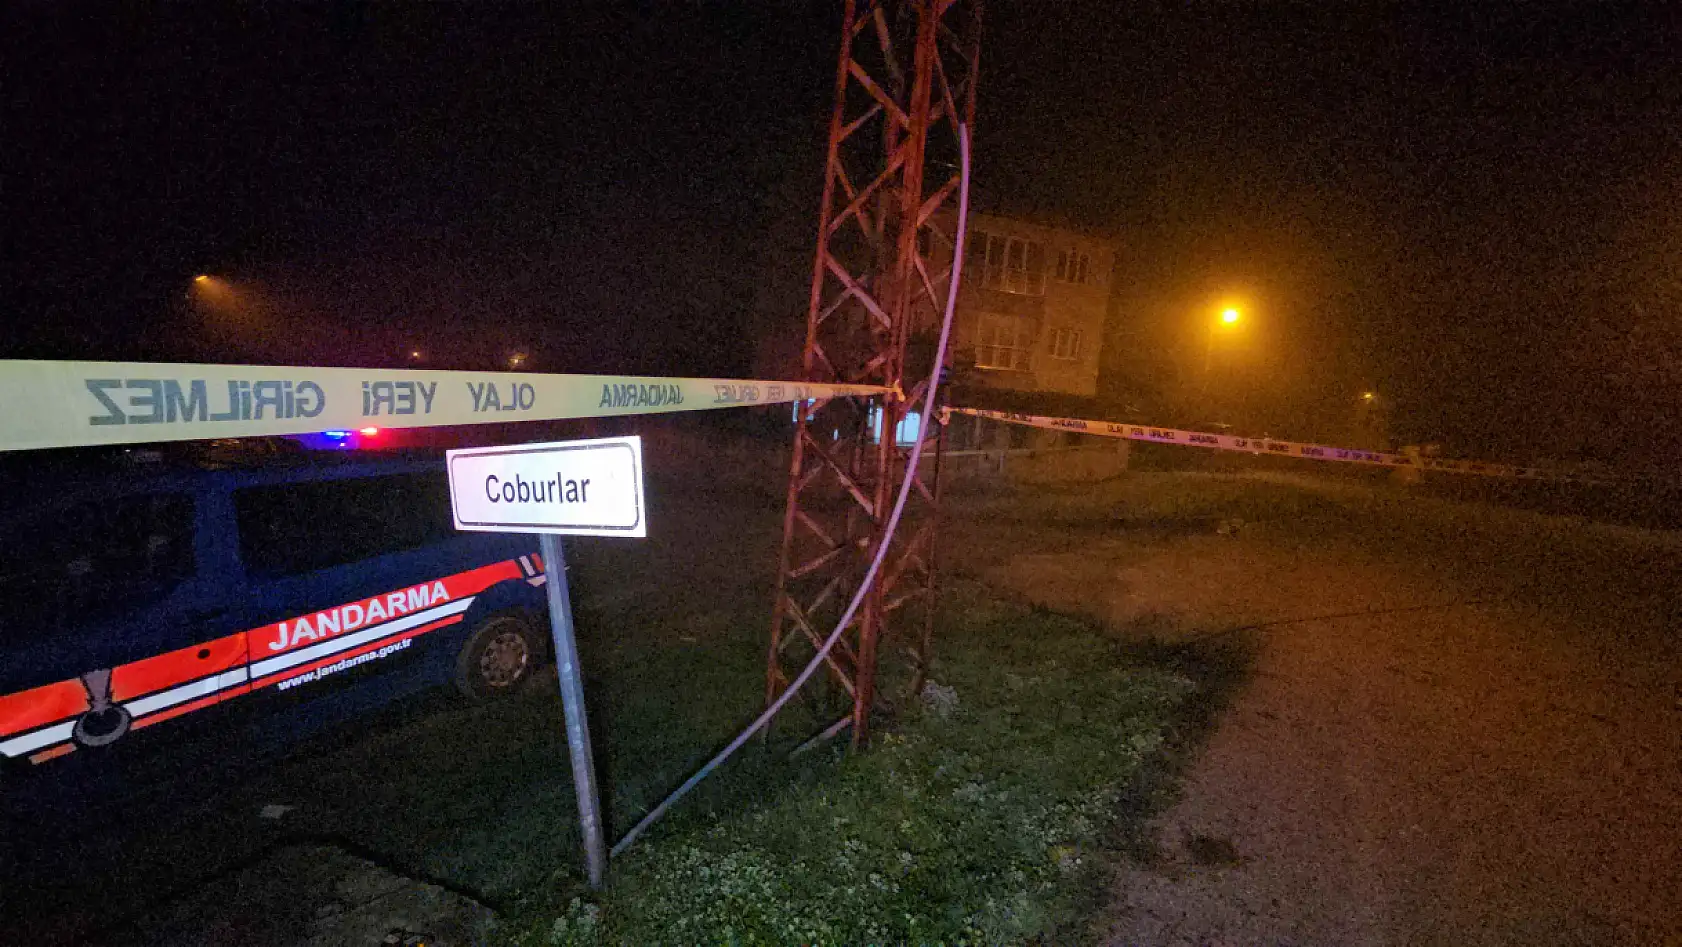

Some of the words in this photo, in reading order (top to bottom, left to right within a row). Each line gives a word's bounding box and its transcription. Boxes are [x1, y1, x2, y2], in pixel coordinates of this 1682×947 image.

[485, 471, 590, 504] Coburlar
[268, 580, 450, 651] JANDARMA
[277, 637, 413, 691] www.jandarma.gov.tr
